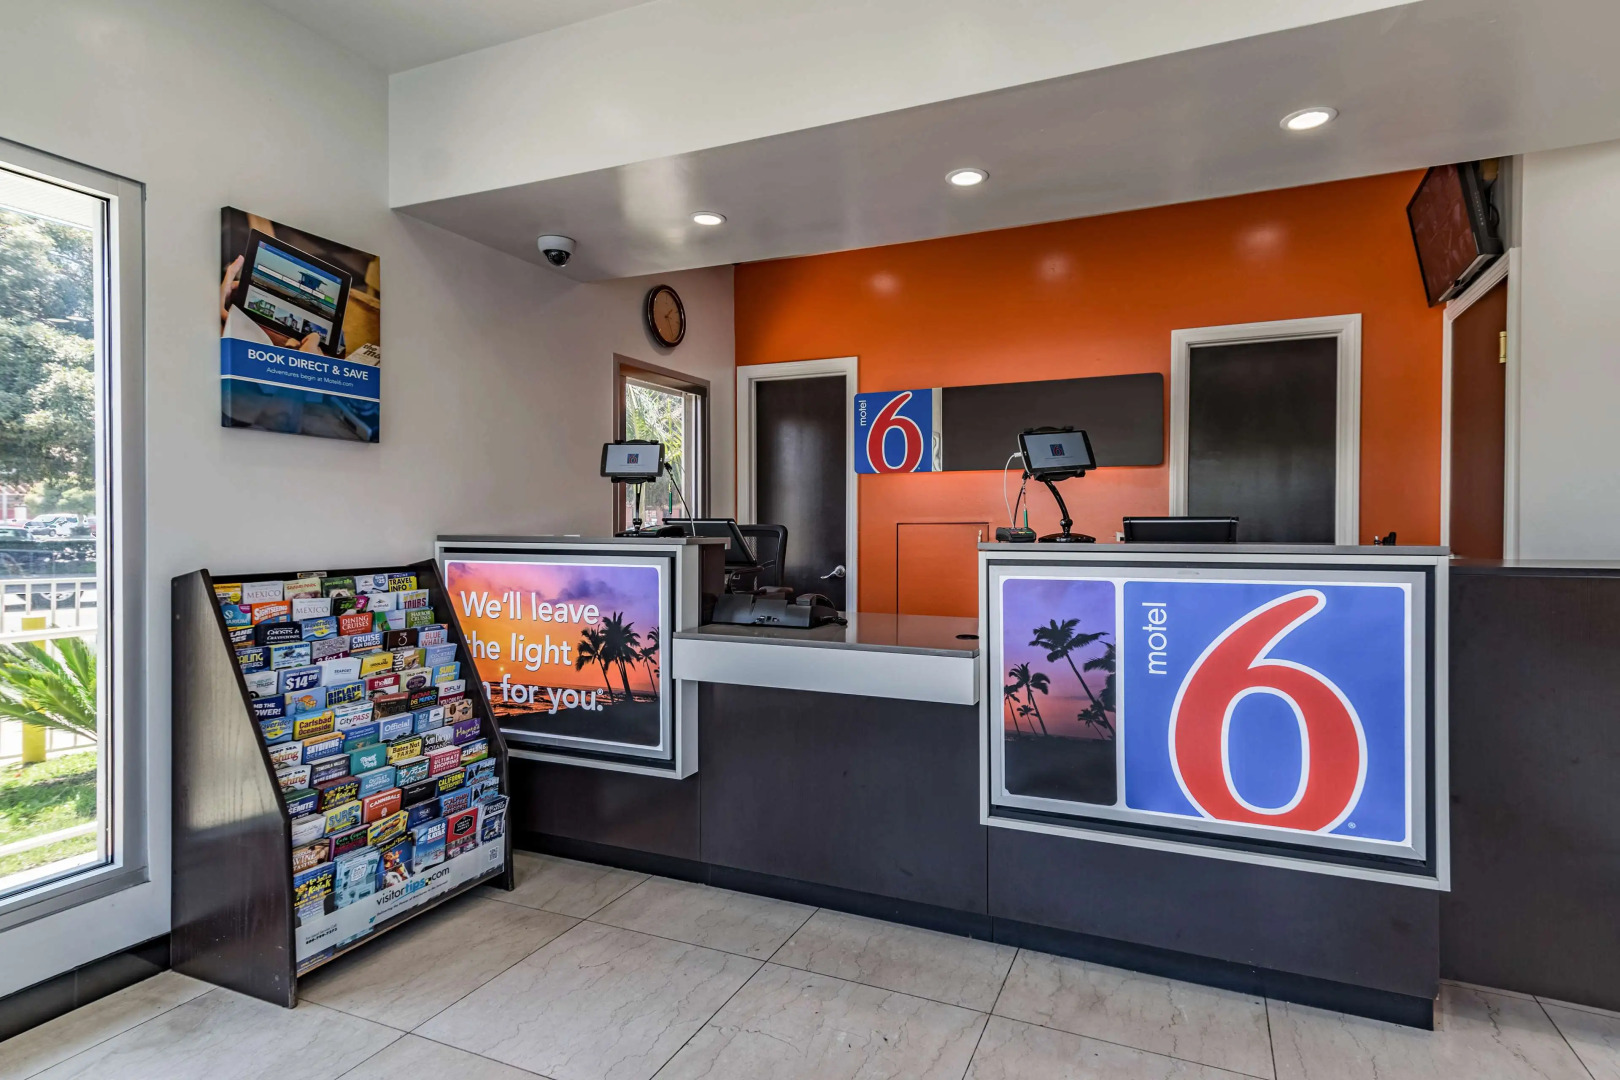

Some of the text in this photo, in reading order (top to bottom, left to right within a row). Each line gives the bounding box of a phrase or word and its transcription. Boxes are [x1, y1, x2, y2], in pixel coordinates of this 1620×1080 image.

[248, 349, 369, 380] BOOK DIRECT & SAVE
[266, 367, 299, 378] Adventures
[300, 374, 316, 382] begin
[858, 400, 866, 426] motel
[866, 391, 924, 474] 6
[246, 590, 280, 598] MEXICO
[404, 598, 426, 609] TOURS
[460, 590, 599, 625] We'll leave
[342, 615, 368, 624] DINING
[342, 622, 368, 630] CRUISES
[352, 634, 380, 644] CRUISE
[1142, 602, 1167, 675] motel
[510, 633, 572, 672] light
[328, 685, 361, 699] BIPLANE
[501, 674, 538, 704] for
[328, 692, 355, 706] RIDES!
[1168, 589, 1368, 833] 6
[299, 716, 332, 729] Carlsbad
[340, 713, 370, 725] CityPASS
[299, 724, 331, 735] Oceanside
[384, 720, 410, 732] Official
[306, 739, 339, 754] SKYDIVING
[426, 736, 434, 746] San
[306, 748, 338, 759] OCEANSIDE
[392, 745, 408, 753] Bates
[396, 749, 414, 757] FARM
[462, 744, 486, 756] ZIPLINE
[438, 772, 464, 786] CALIFORNIA
[370, 794, 400, 807] CANNIBALS
[427, 828, 445, 840] KAYAK
[429, 824, 440, 833] BIKE
[292, 854, 315, 865] WINE
